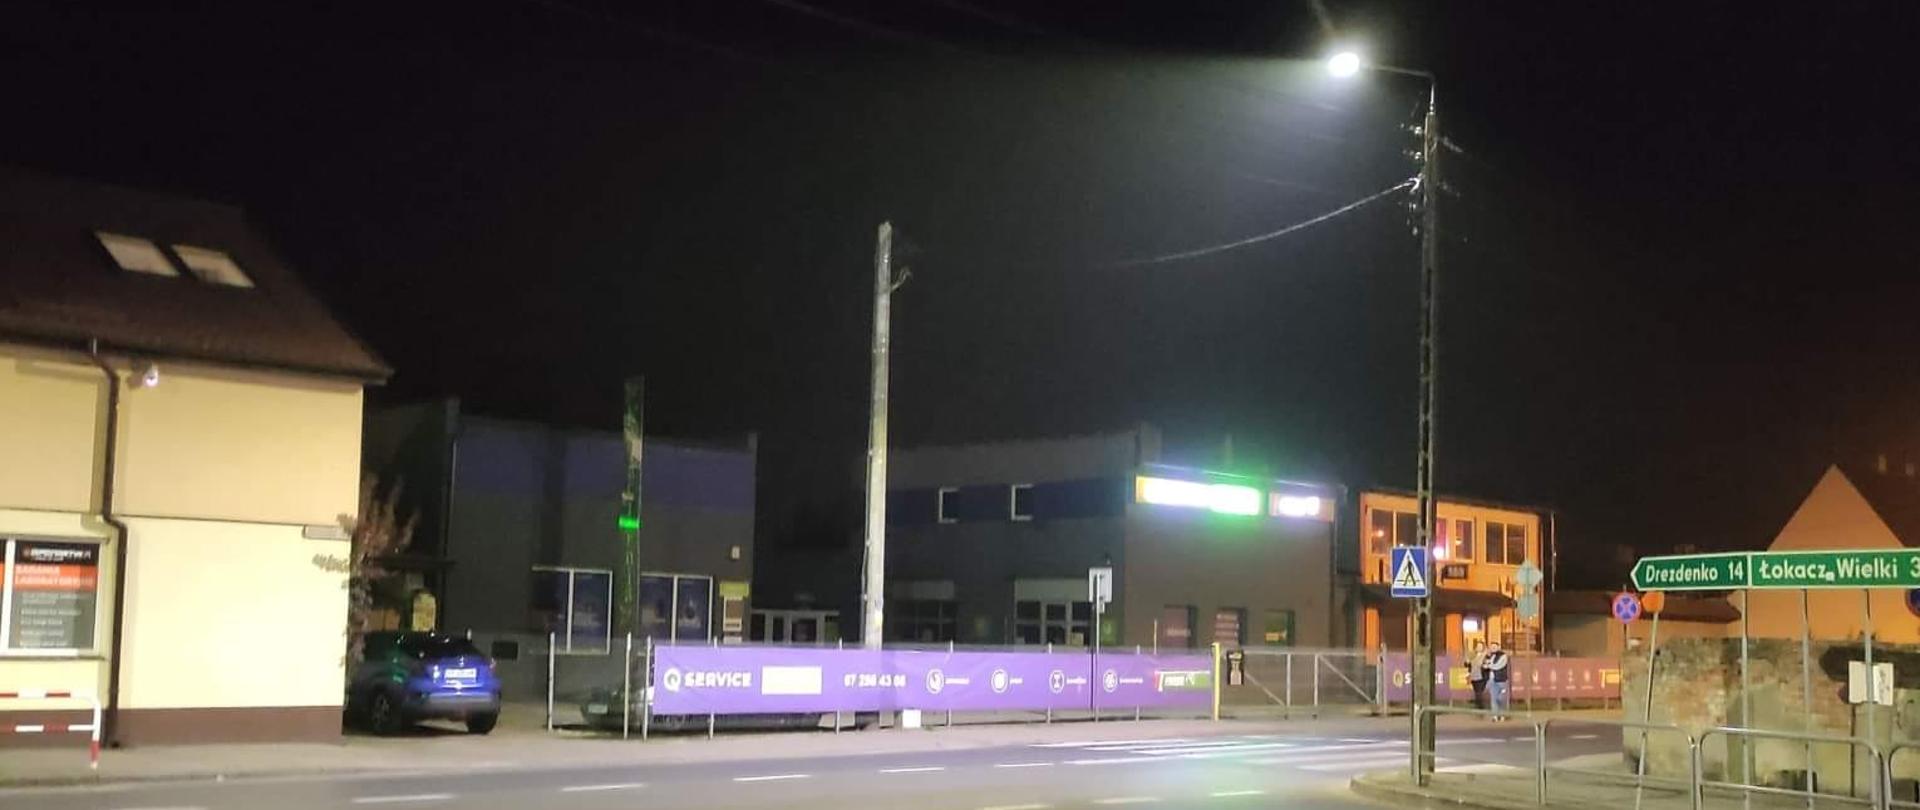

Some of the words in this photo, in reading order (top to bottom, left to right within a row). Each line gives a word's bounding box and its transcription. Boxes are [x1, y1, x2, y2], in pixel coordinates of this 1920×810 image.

[1645, 564, 1718, 583] Drezdenko
[1728, 561, 1744, 579] 14
[1759, 559, 1826, 579] Łokacz
[1836, 557, 1898, 579] Wielki
[685, 671, 752, 687] SERVICE
